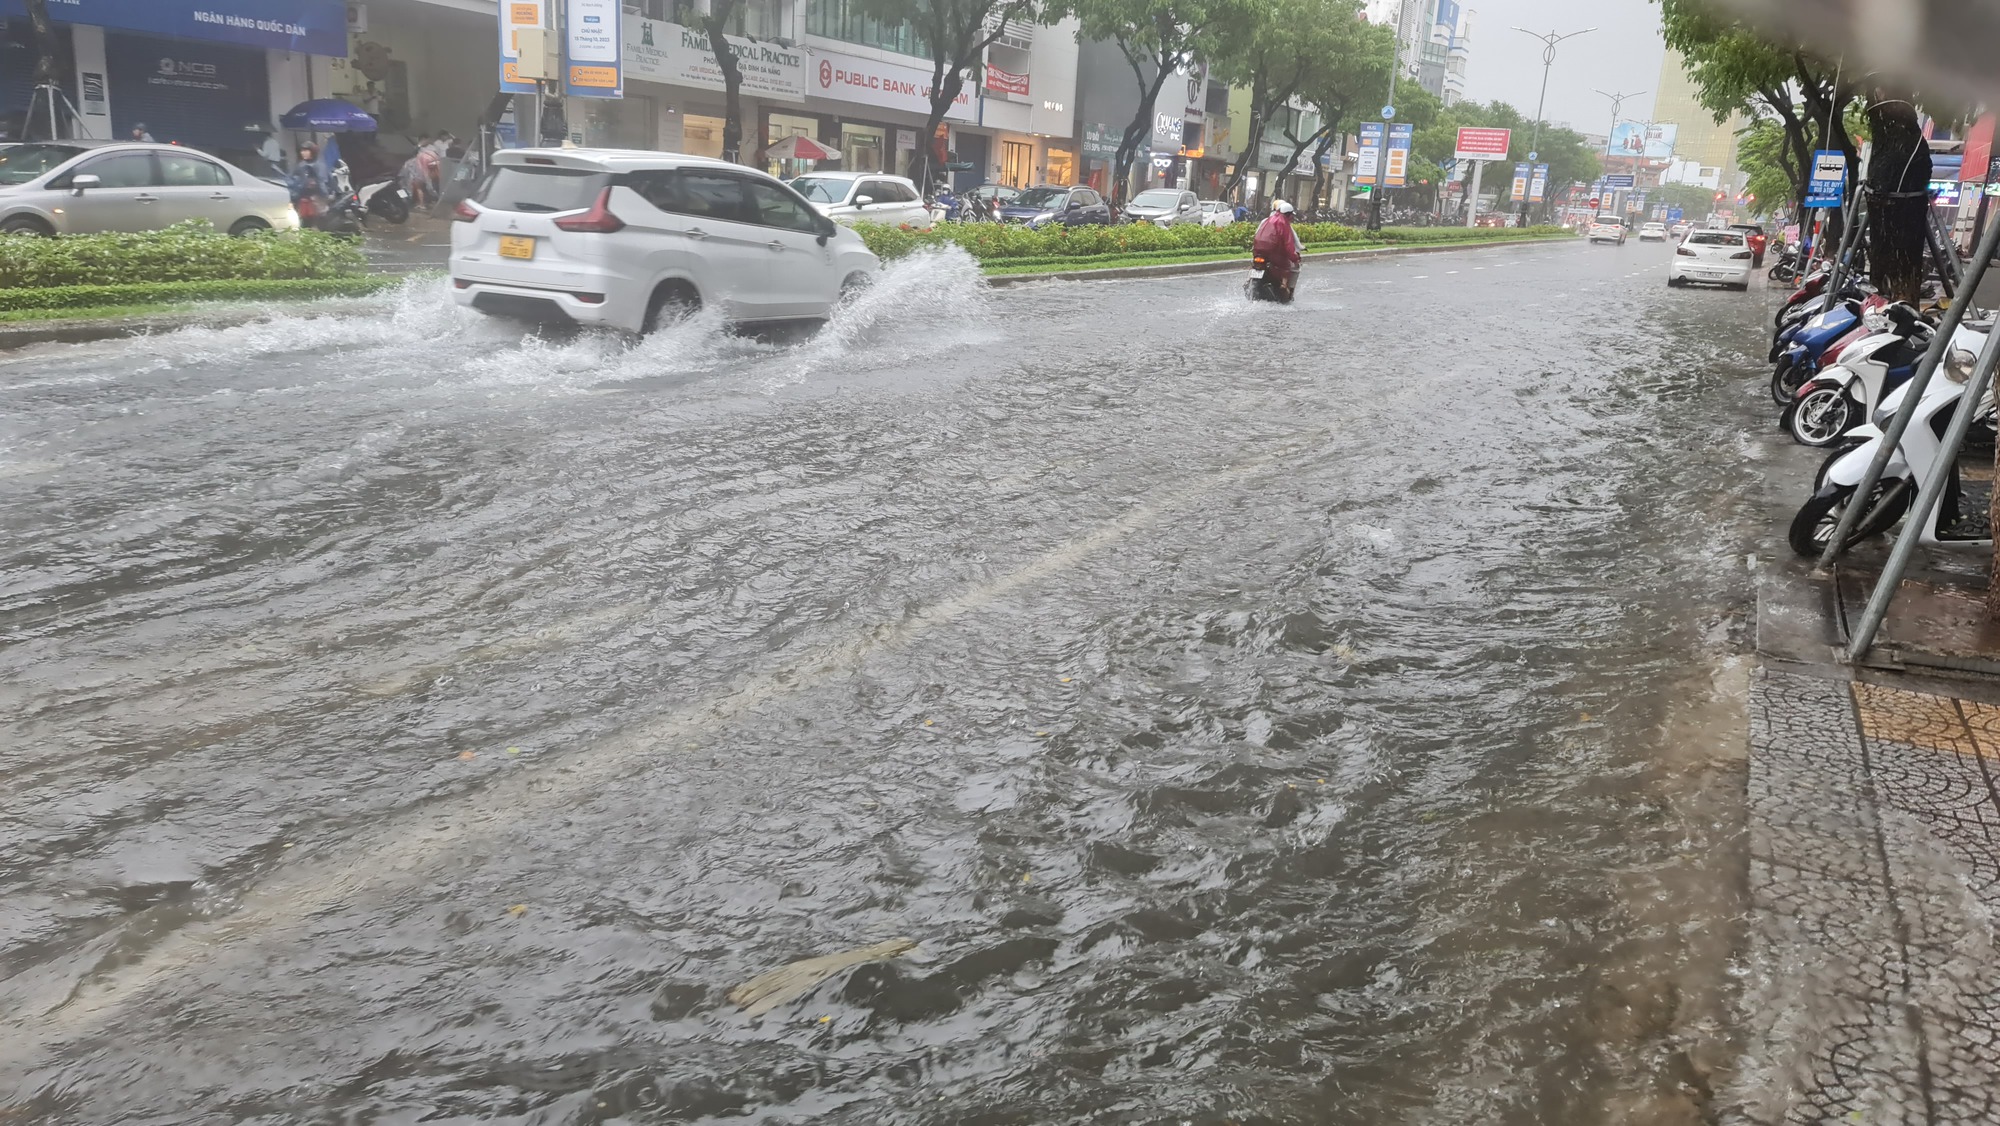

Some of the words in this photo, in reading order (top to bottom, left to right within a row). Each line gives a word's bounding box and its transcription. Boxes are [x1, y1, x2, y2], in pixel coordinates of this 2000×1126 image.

[194, 11, 224, 25] NGÂN
[226, 14, 256, 29] HÀNG
[256, 19, 284, 33] QUỐC
[285, 23, 306, 36] DÂN
[626, 43, 645, 54] FAMILY
[645, 46, 668, 58] MEDICAL
[681, 31, 715, 52] FAMIL
[728, 44, 759, 61] EDICAL
[760, 47, 800, 68] PRACTICE
[178, 61, 216, 74] NCB
[635, 54, 660, 66] PRACTICE
[835, 69, 879, 89] PUBLIC
[883, 79, 916, 96] BANK
